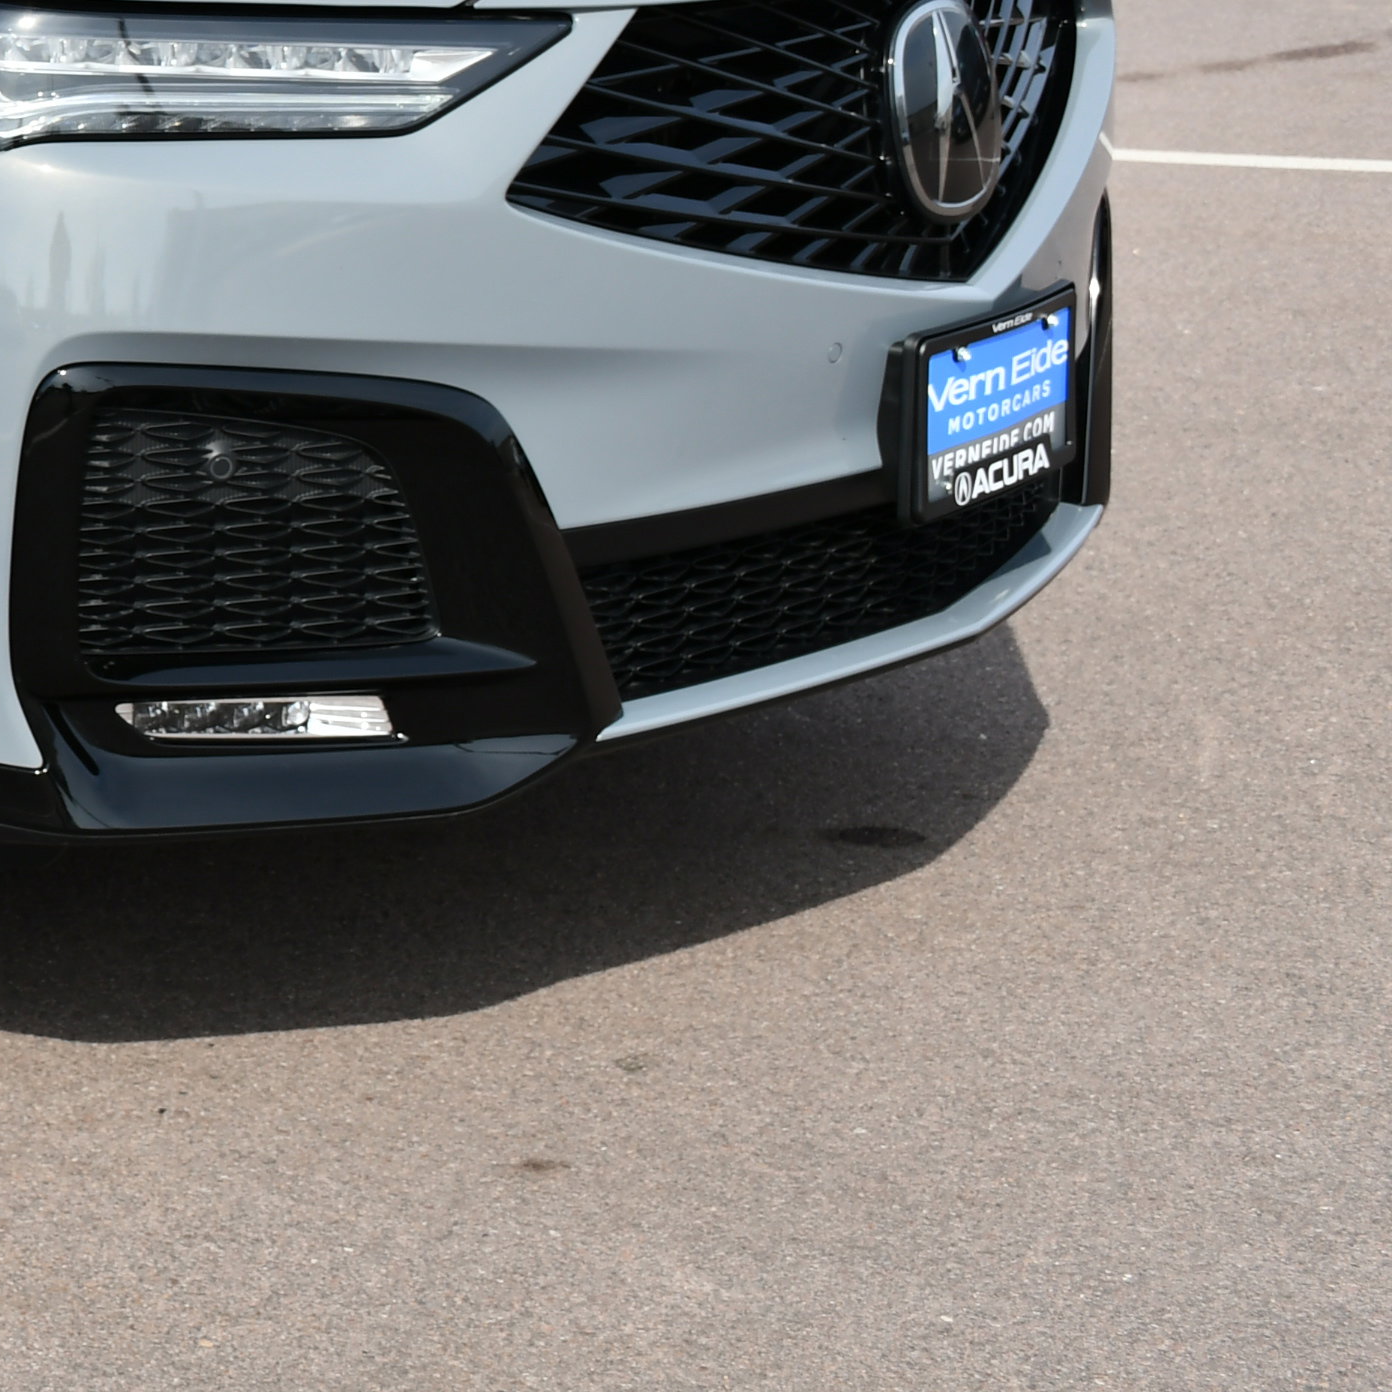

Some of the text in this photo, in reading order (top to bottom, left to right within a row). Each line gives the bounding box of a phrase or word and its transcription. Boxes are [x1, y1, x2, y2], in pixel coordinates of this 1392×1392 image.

[991, 312, 1033, 333] Vern Eide
[927, 339, 1069, 413] Vern Eide
[947, 379, 1052, 436] MOTORCARS
[932, 411, 1055, 480] VERNEIDECOM
[971, 442, 1050, 499] ACURA
